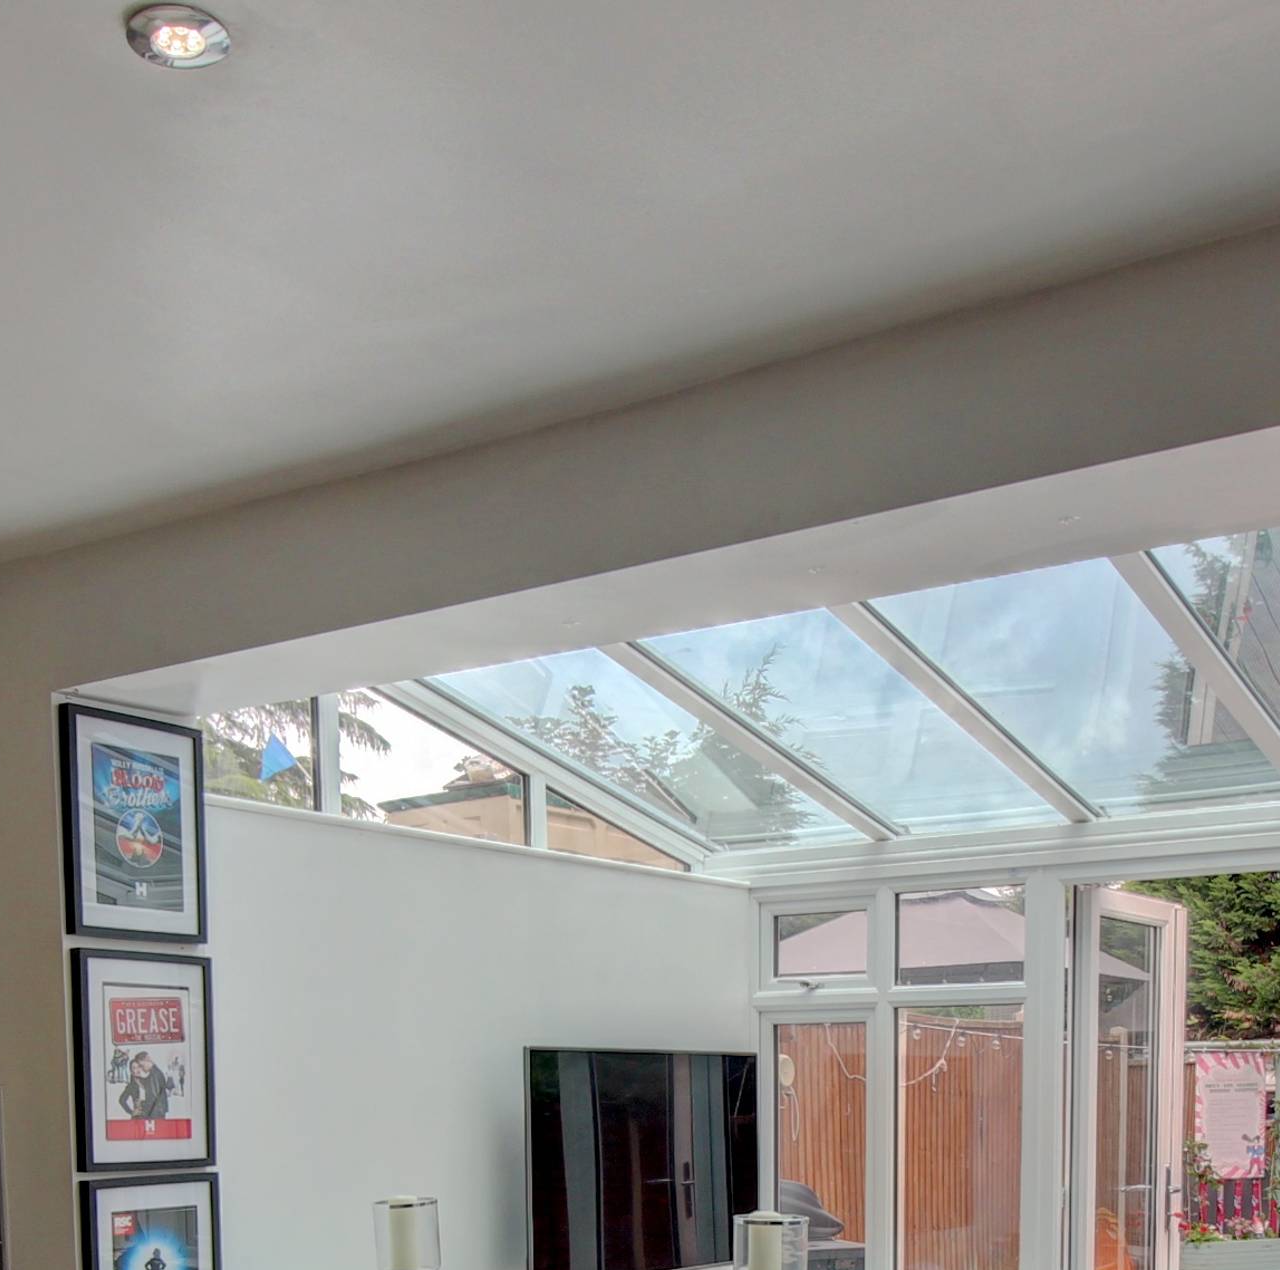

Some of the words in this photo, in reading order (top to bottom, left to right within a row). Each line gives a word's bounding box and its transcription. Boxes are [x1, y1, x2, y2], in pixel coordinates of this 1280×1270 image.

[135, 881, 147, 897] H
[116, 1008, 179, 1034] GREASE
[145, 1119, 156, 1132] H
